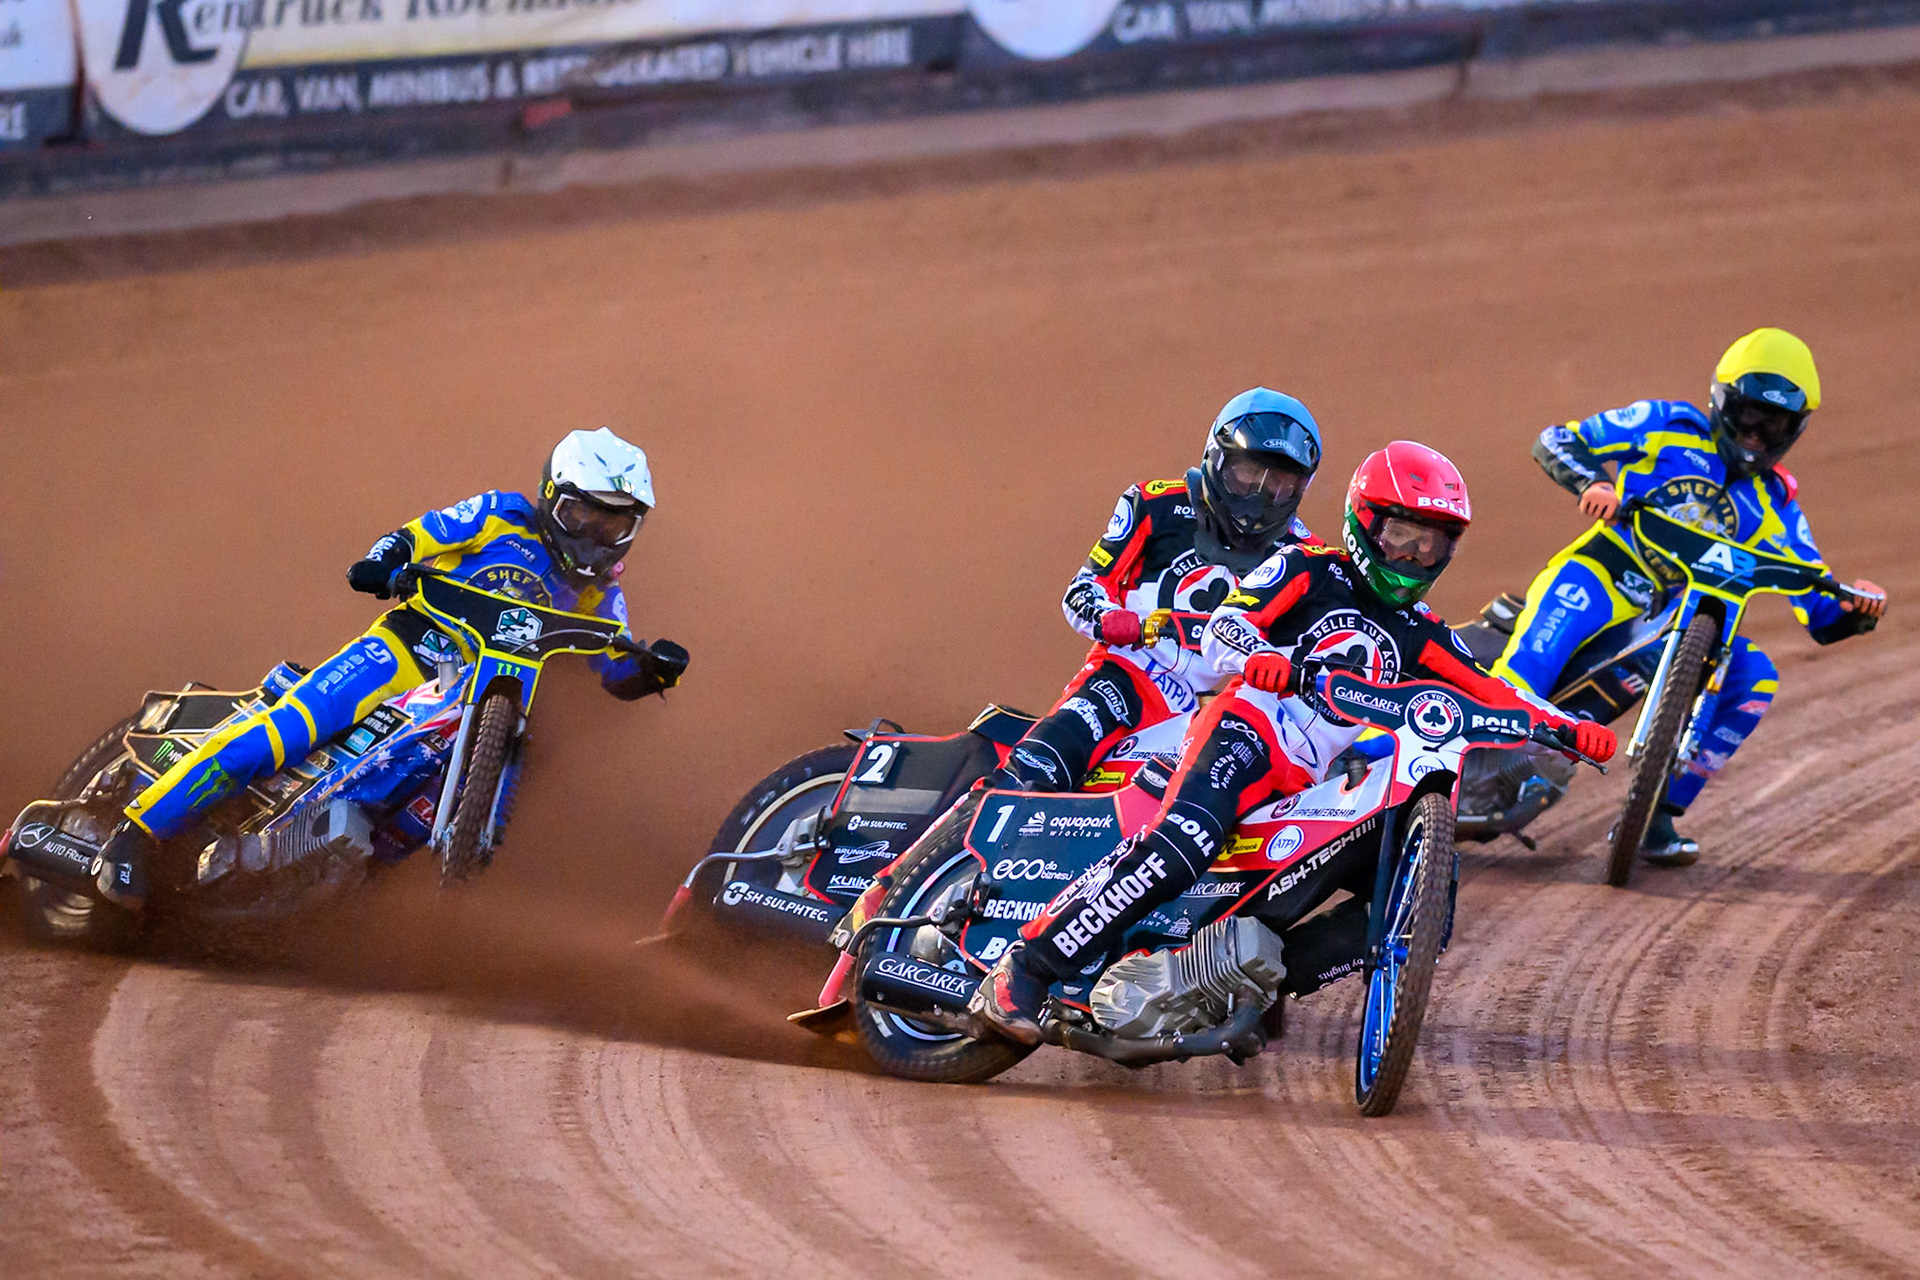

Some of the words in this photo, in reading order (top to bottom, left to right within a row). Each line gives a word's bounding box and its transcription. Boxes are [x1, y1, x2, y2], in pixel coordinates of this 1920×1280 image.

[368, 62, 491, 106] MINIBUS
[494, 60, 519, 98] &
[1172, 555, 1203, 577] BELL
[1152, 672, 1188, 706] ATPI
[1333, 685, 1404, 716] GARCAREK
[857, 744, 893, 782] 2
[1209, 754, 1236, 790] EASTERN
[986, 804, 1016, 843] 1
[1049, 814, 1114, 831] aquapark
[1166, 812, 1218, 858] BOLL
[42, 840, 67, 856] AUTO
[833, 847, 899, 860] BRUNKHORST
[992, 858, 1045, 881] eco
[1267, 830, 1356, 901] ASH-TECH
[1051, 850, 1169, 959] BECKHOFF
[1185, 881, 1245, 896] ARCAREK
[744, 889, 762, 906] SH
[762, 893, 830, 923] SULPHTEC.
[983, 898, 1049, 921] BECKHO
[877, 957, 974, 996] GARCAREK
